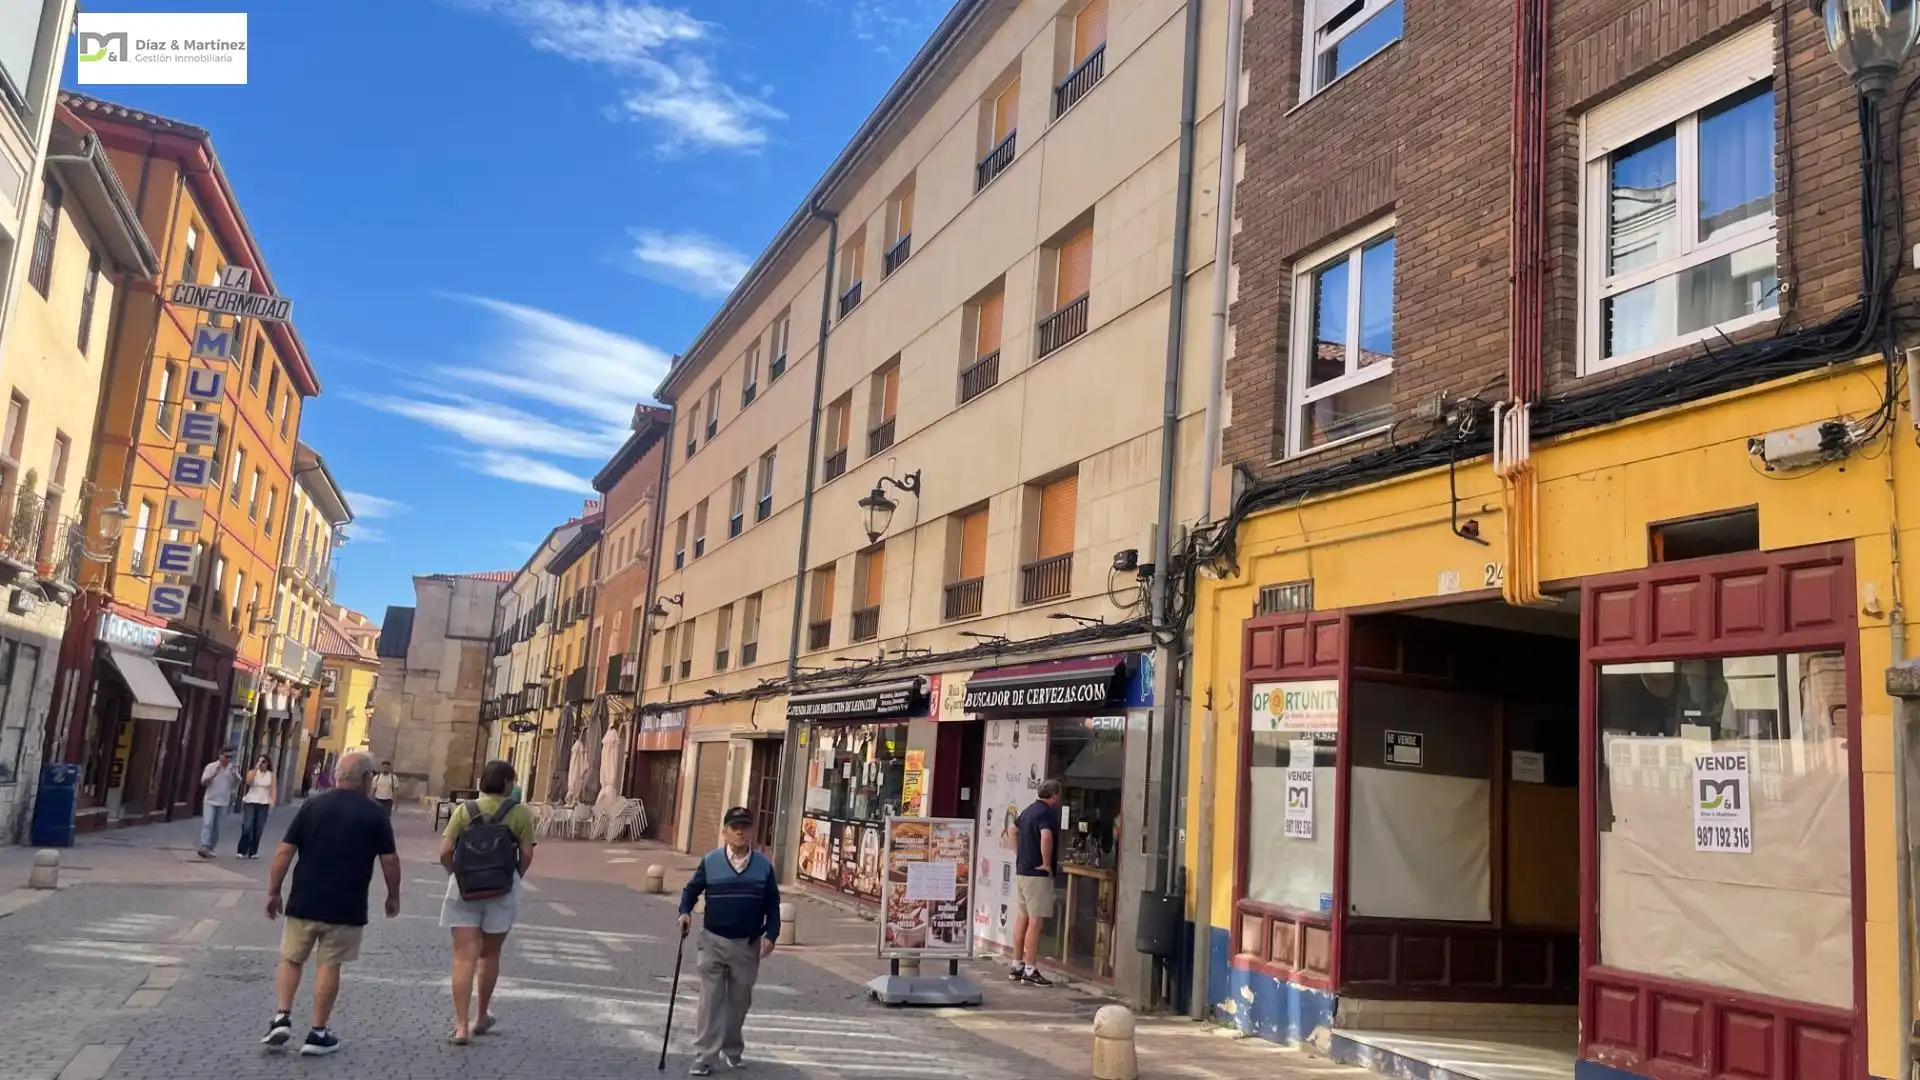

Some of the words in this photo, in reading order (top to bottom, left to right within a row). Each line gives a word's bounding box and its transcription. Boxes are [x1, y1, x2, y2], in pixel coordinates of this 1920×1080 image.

[223, 267, 248, 289] LA
[172, 283, 290, 320] CONFORMIDAD
[152, 329, 228, 615] MUEBLES
[964, 688, 1010, 708] BUSCADOR
[1011, 688, 1025, 706] DE
[1026, 682, 1106, 704] CERVEZAS.COM
[820, 701, 845, 714] PRODUCTOS
[1387, 733, 1395, 744] SE
[1397, 734, 1417, 746] VENDE
[1695, 756, 1746, 771] VENDE
[1287, 771, 1312, 781] VENDE
[1697, 826, 1713, 846] 987
[1715, 827, 1731, 847] 192
[1733, 827, 1749, 848] 316
